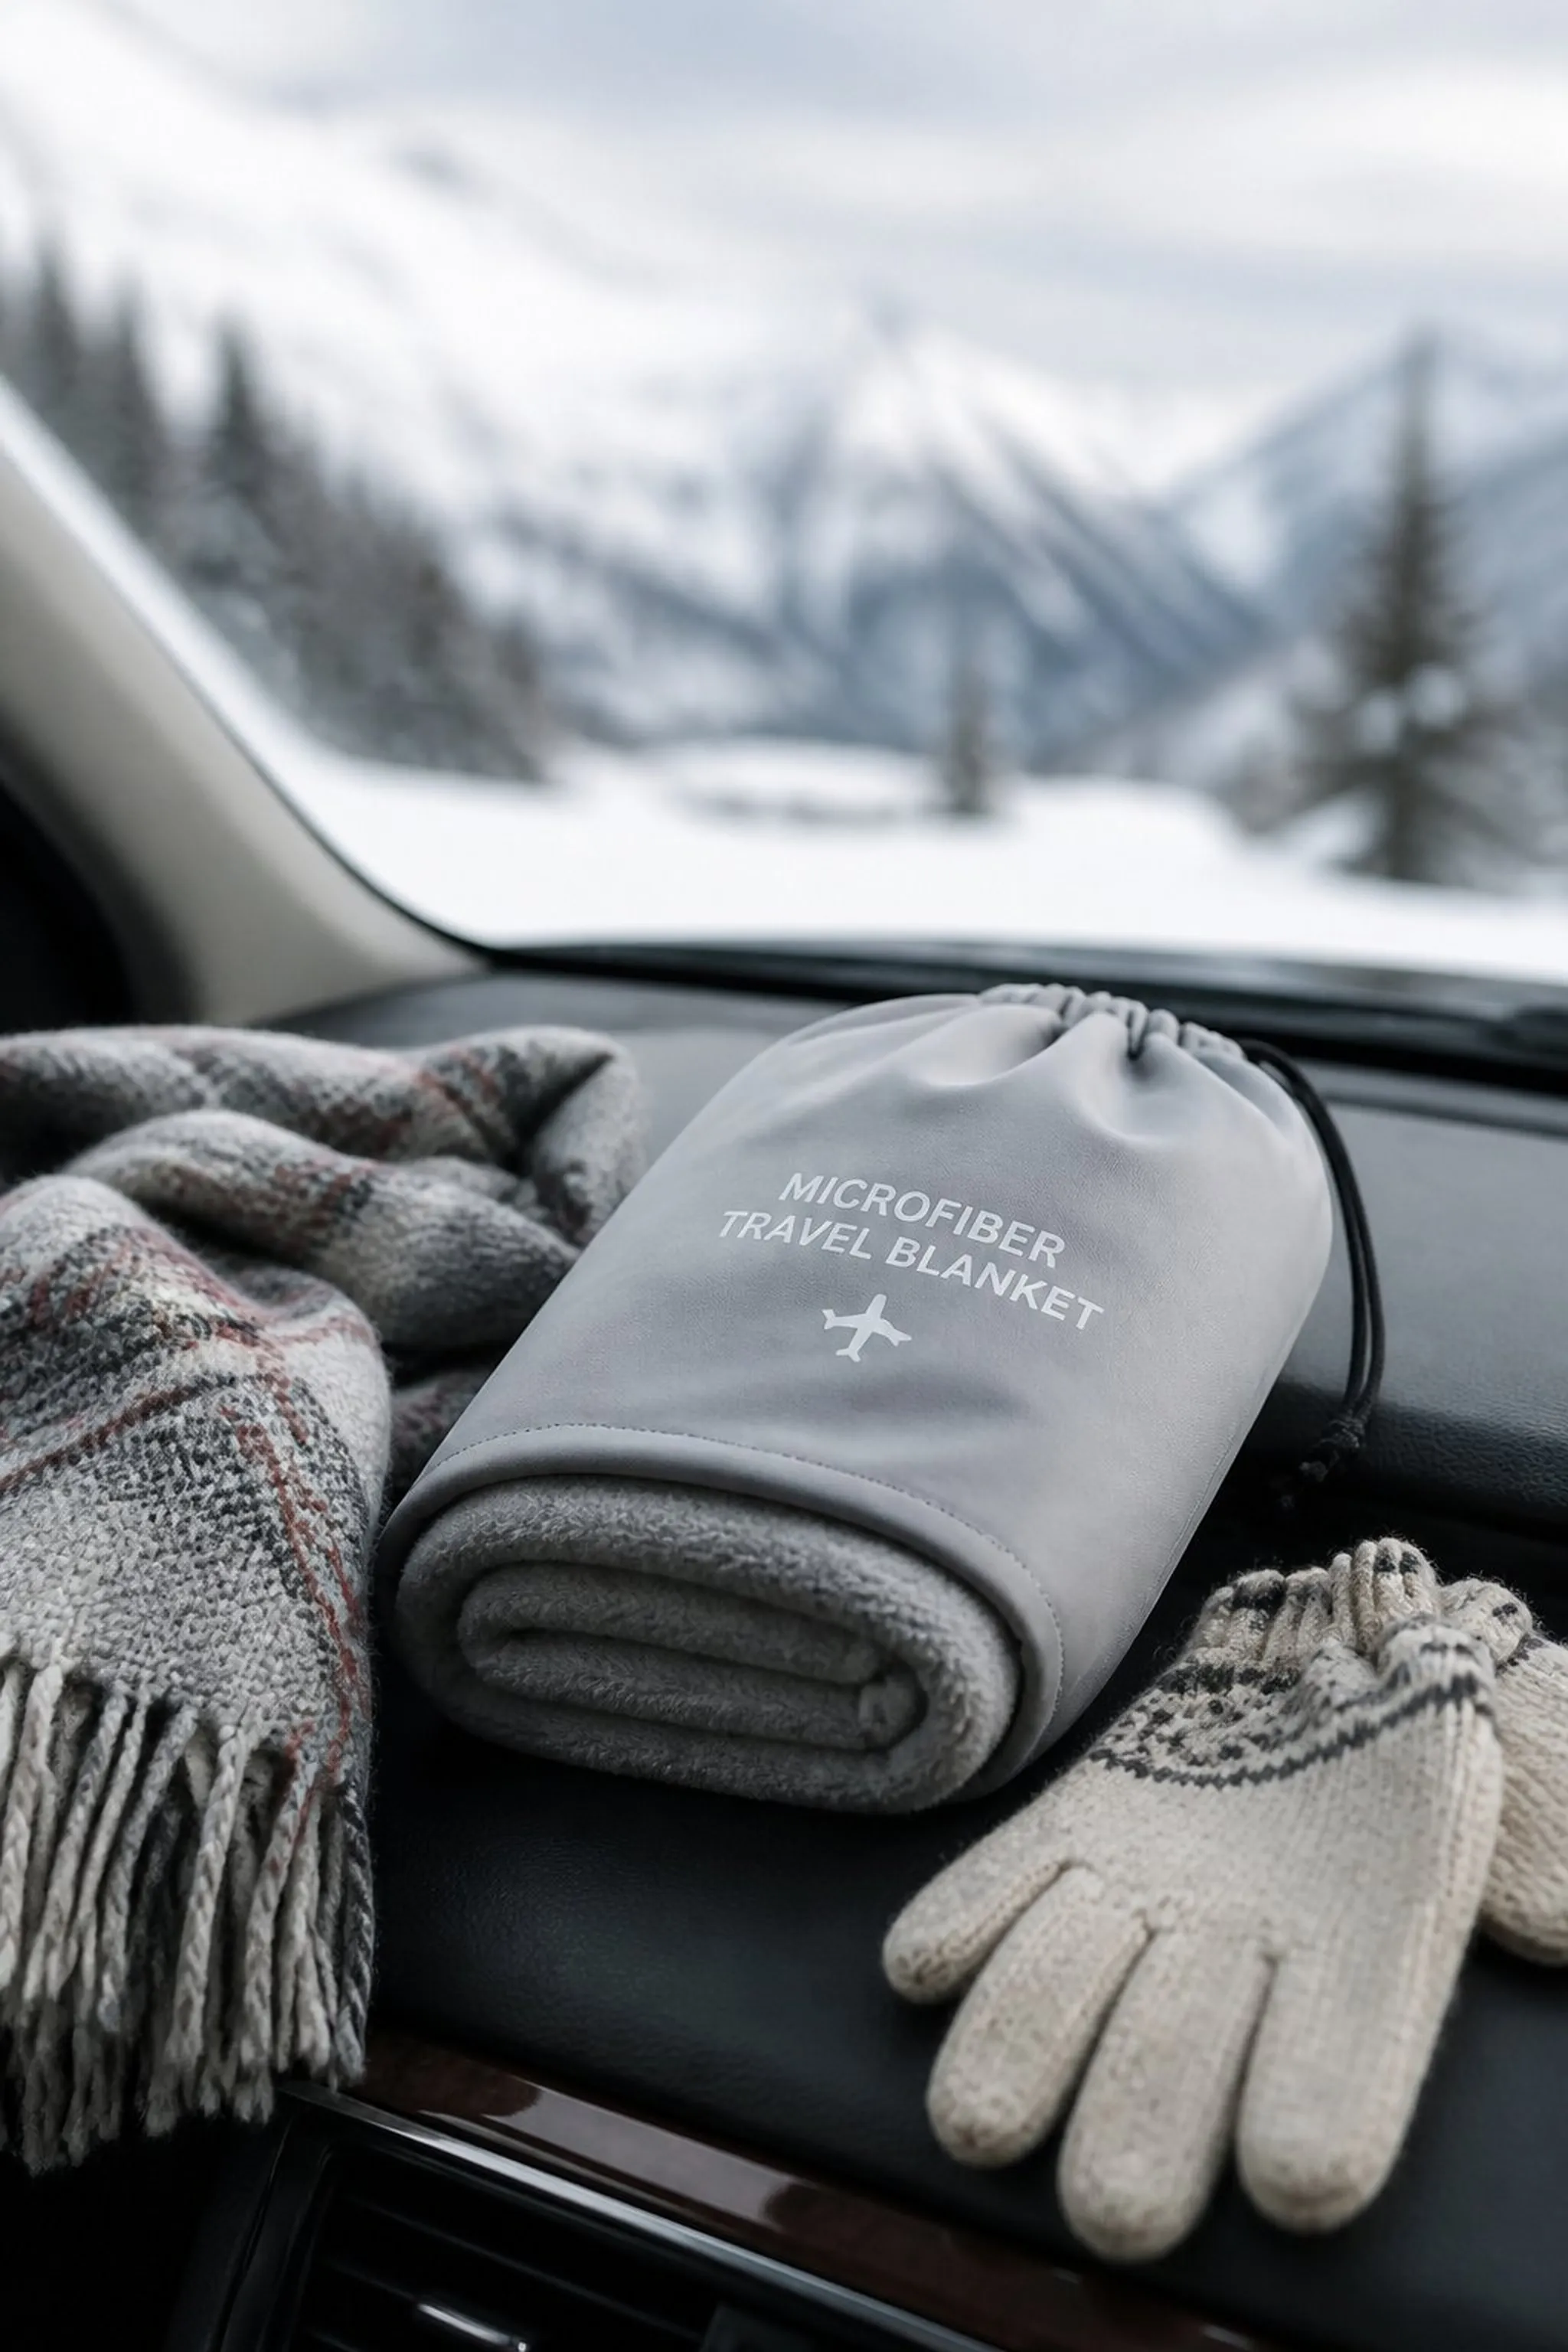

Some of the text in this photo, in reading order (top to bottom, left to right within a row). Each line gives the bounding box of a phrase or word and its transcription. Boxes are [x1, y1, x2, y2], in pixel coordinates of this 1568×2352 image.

[719, 1210, 1105, 1331] TRAVEL BLANKET
[778, 1172, 1065, 1269] MICROFIBER
